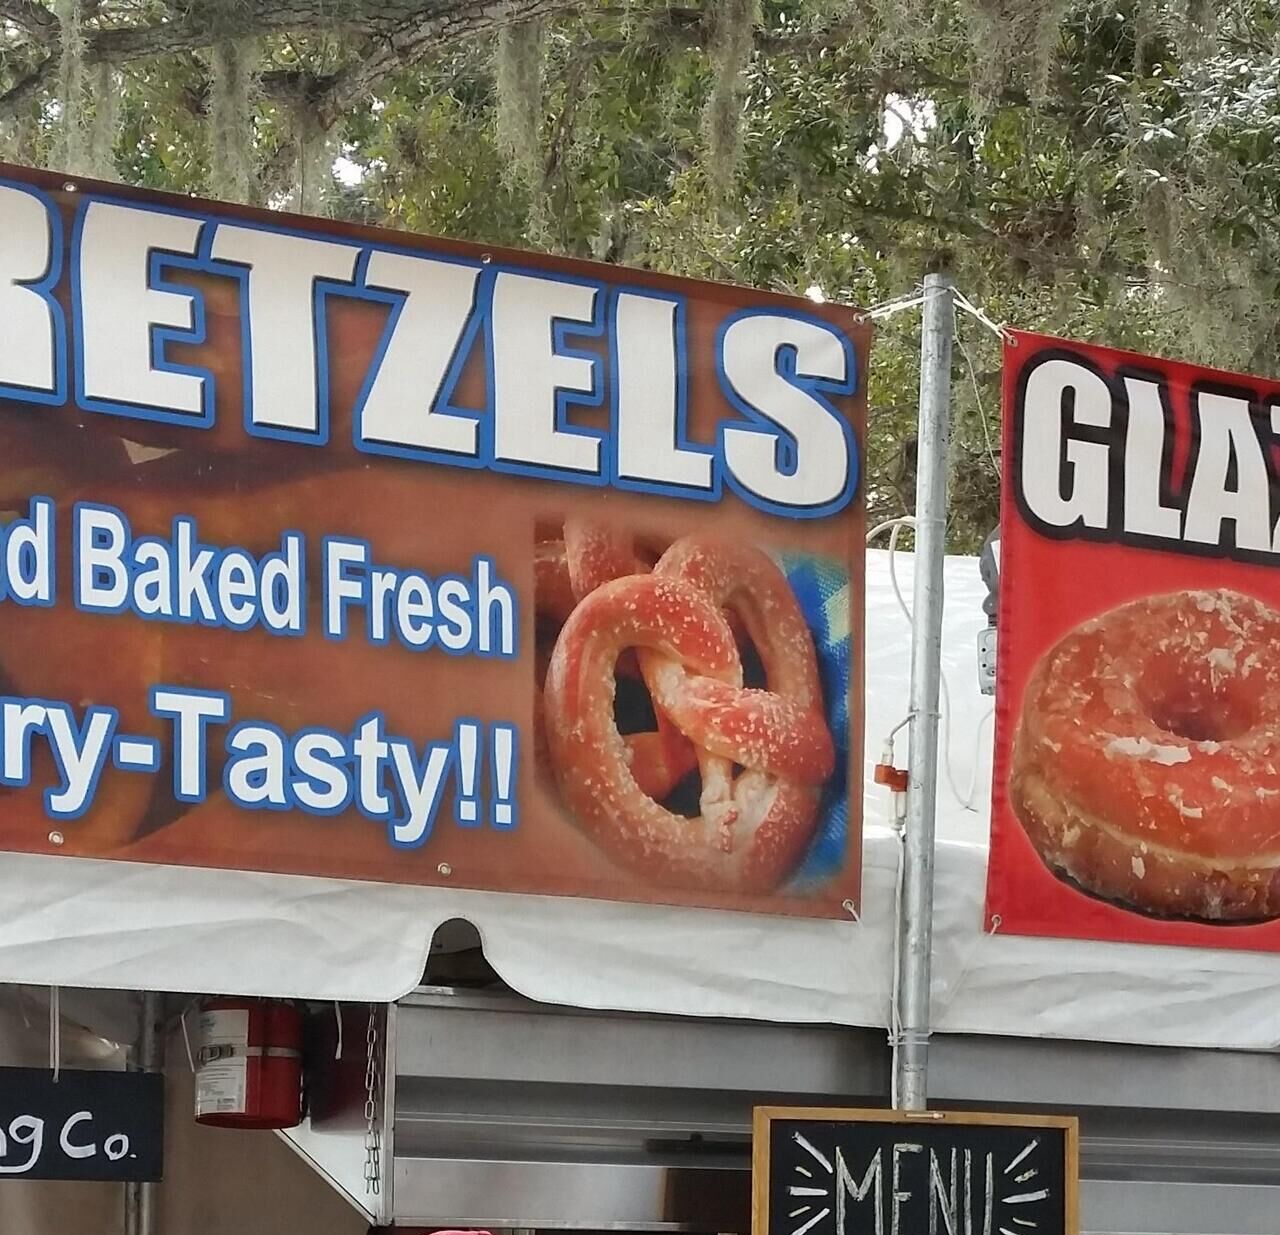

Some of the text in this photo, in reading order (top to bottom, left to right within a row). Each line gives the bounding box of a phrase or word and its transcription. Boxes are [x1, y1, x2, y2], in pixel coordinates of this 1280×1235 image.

[77, 508, 304, 634] Baked
[324, 540, 519, 659] Fresh
[59, 1109, 137, 1162] Co.
